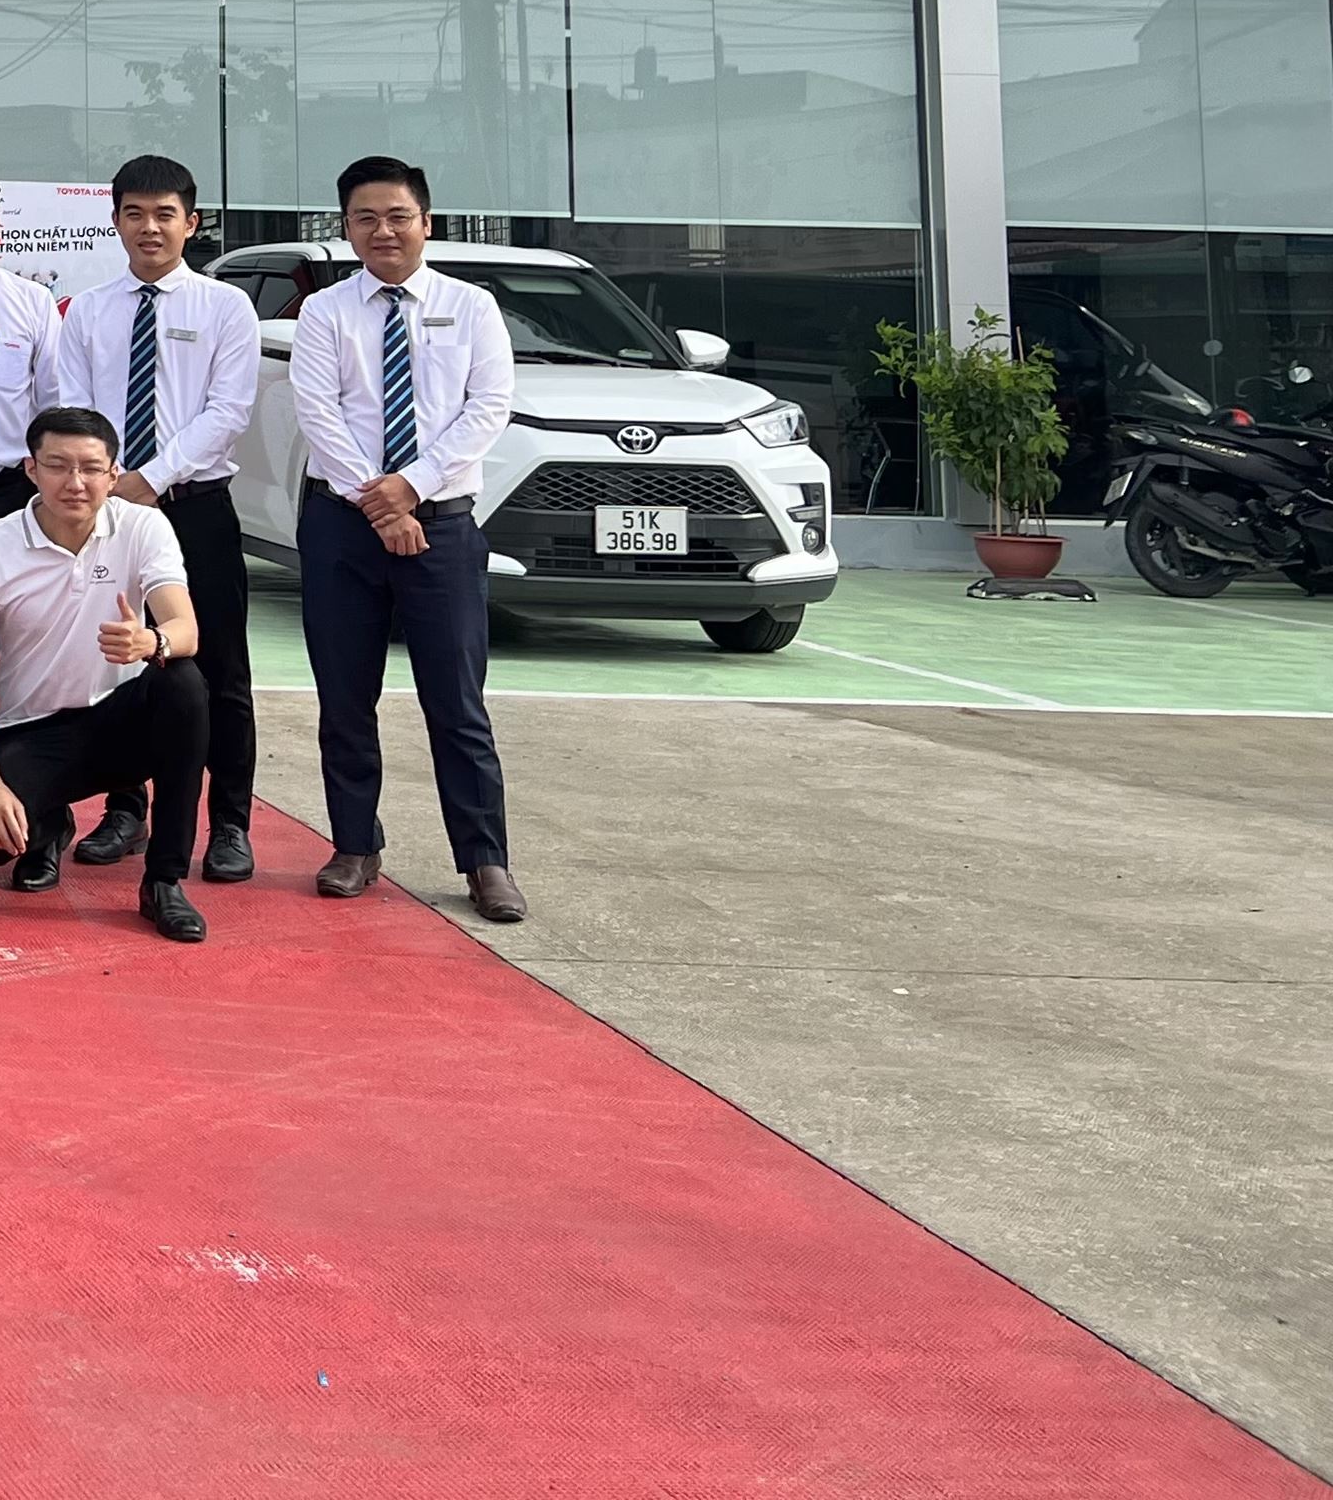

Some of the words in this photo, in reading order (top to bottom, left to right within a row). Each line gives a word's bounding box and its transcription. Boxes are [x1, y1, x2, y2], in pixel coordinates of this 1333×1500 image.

[56, 187, 91, 196] TOYOTA
[93, 188, 113, 197] LON
[34, 225, 67, 240] CHẤT
[70, 226, 117, 241] LƯỢNG
[0, 243, 34, 255] TRỌN
[72, 241, 94, 251] TIN
[622, 510, 660, 529] 51K
[606, 531, 677, 551] 386.98
